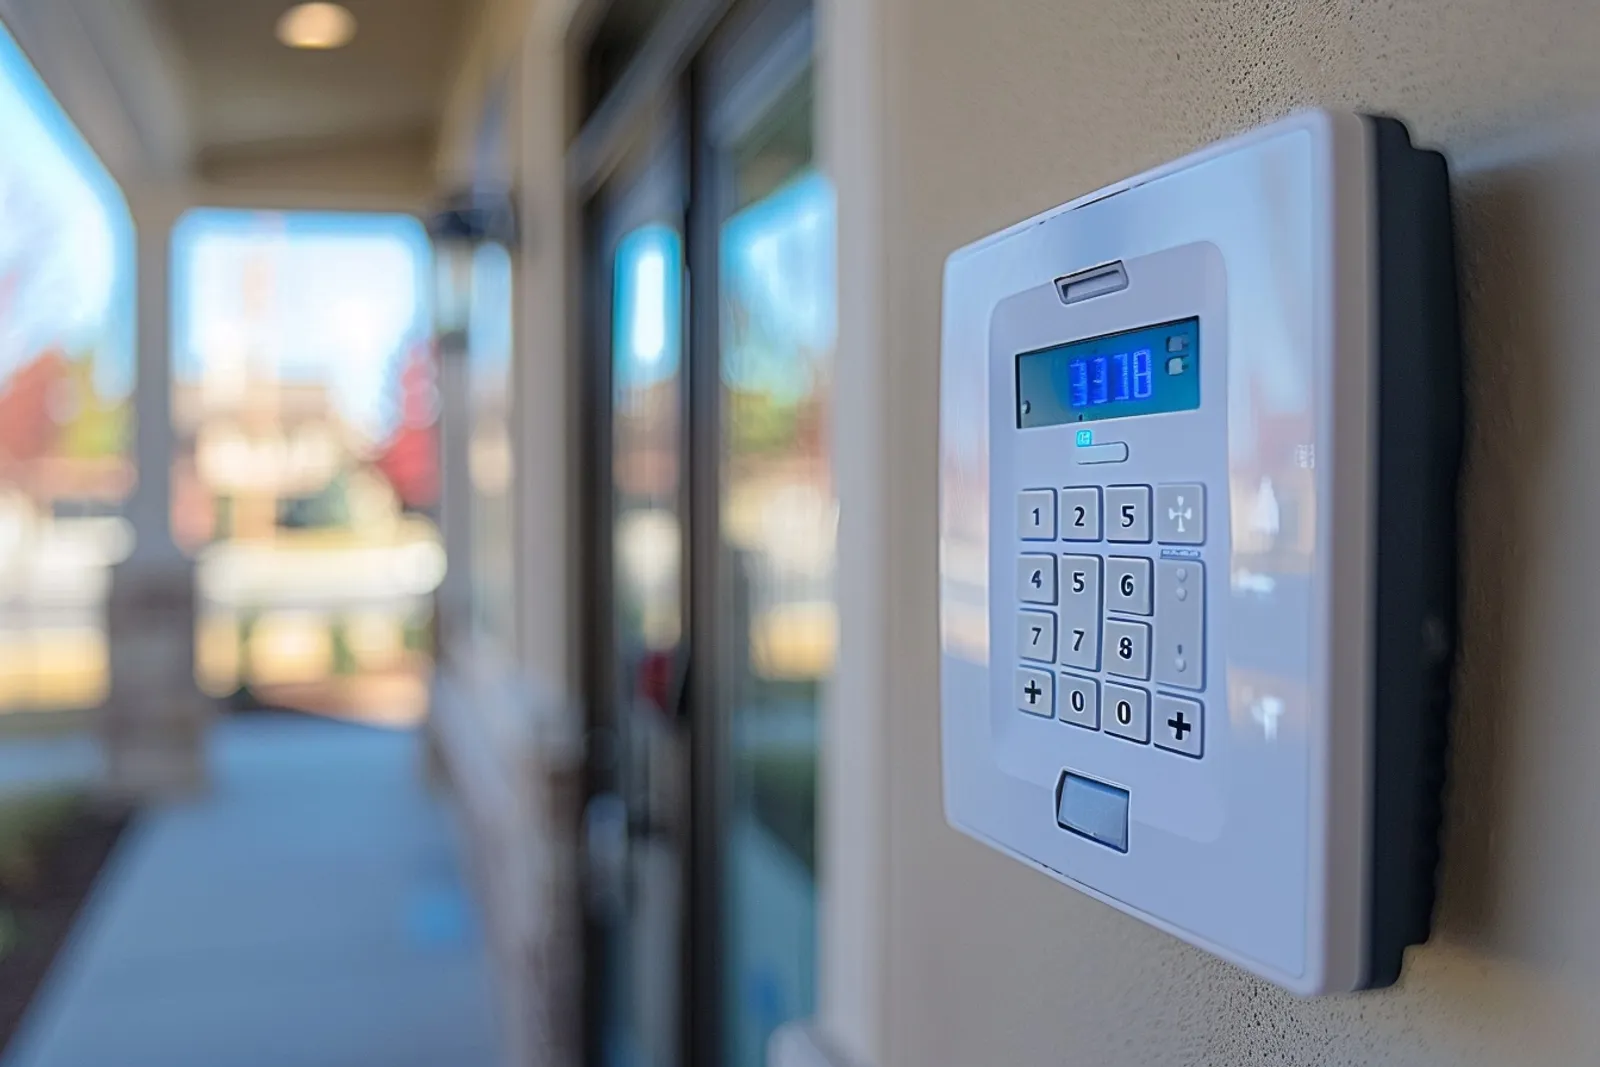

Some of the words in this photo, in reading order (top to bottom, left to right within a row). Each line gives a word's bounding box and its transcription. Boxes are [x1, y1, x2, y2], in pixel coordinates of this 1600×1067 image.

[1031, 507, 1040, 526] 1
[1074, 506, 1086, 527] 2
[1121, 505, 1135, 528] 5
[1031, 569, 1042, 589] 4
[1072, 571, 1085, 593] 5
[1120, 574, 1134, 597] 6
[1031, 627, 1042, 646] 7
[1072, 629, 1085, 652] 7
[1119, 636, 1133, 660] 8
[1071, 690, 1085, 712] 0
[1117, 700, 1132, 725] 0
